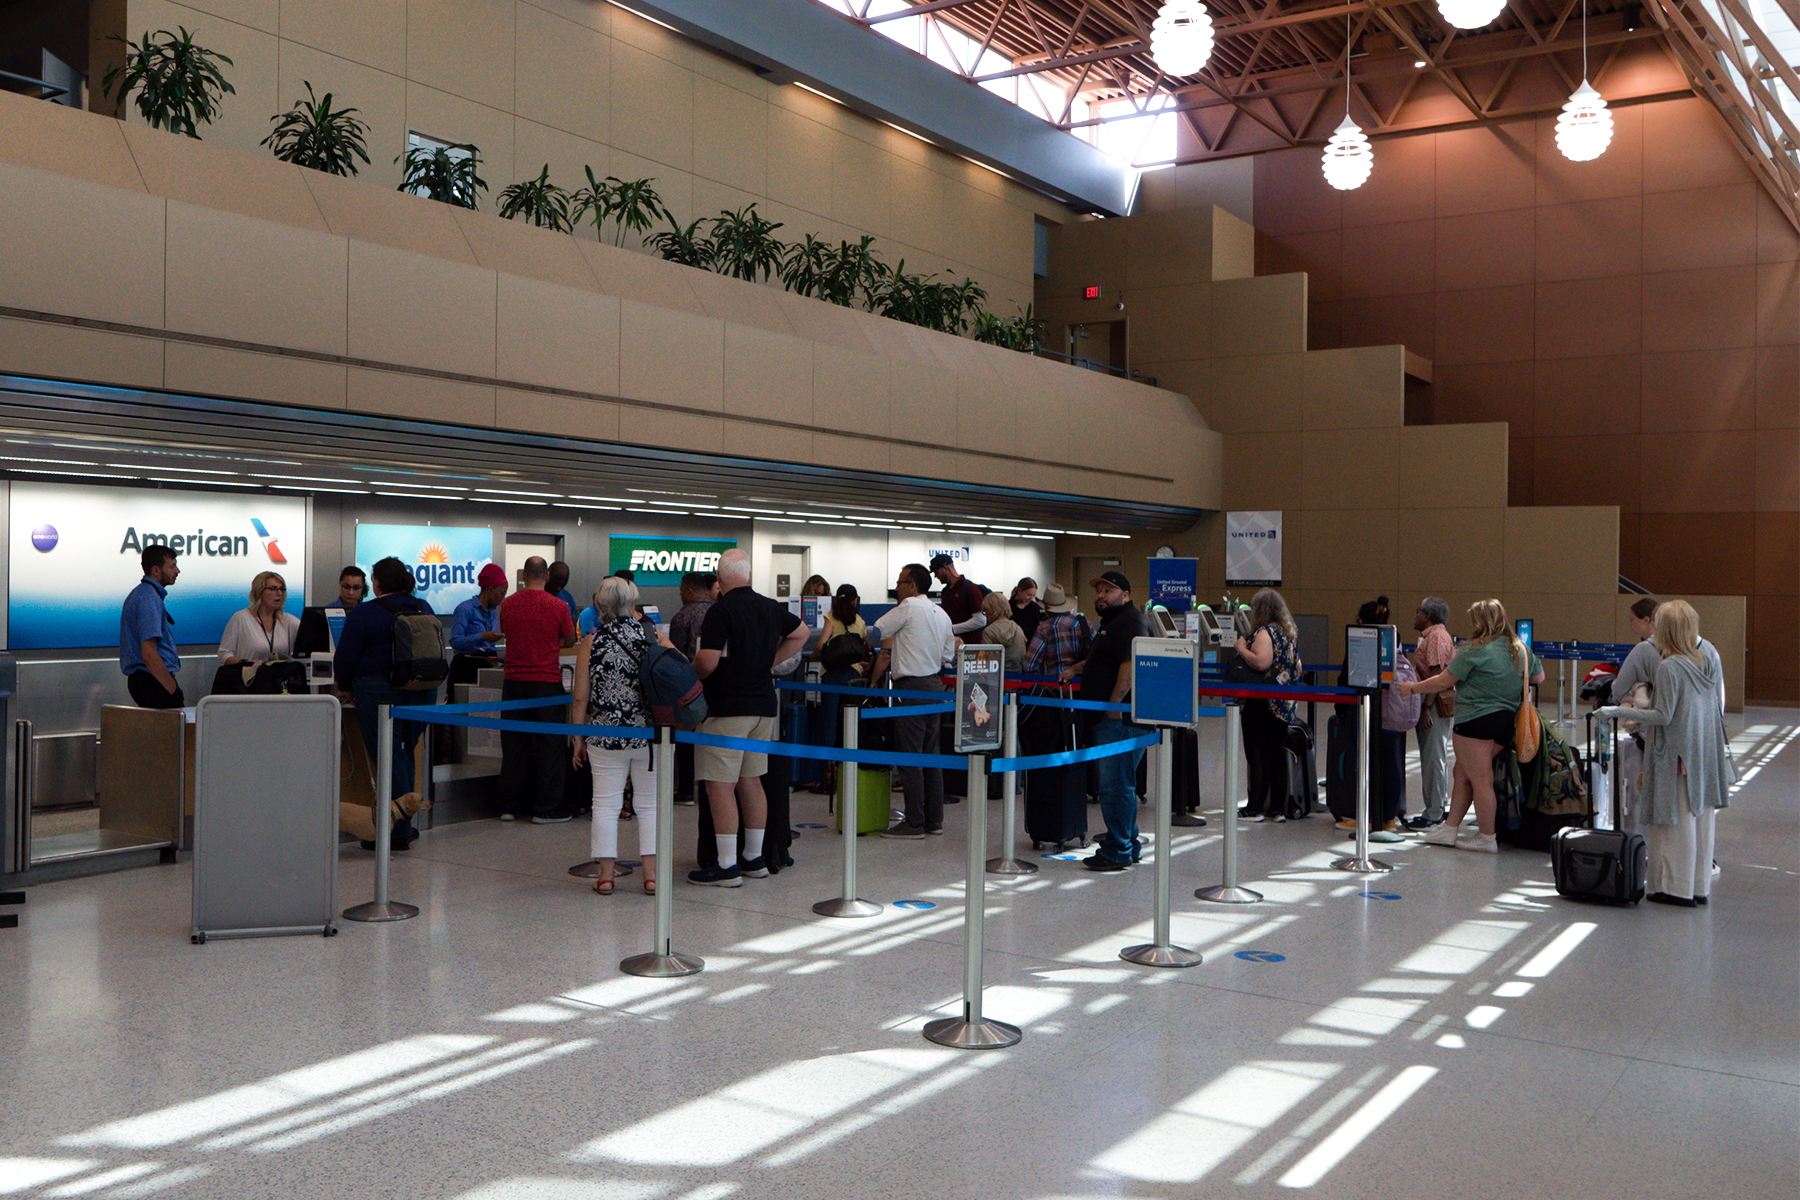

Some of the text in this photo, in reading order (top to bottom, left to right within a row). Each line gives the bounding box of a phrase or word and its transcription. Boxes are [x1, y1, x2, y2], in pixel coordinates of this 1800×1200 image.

[1086, 287, 1098, 298] EXIT
[120, 526, 248, 556] American
[629, 550, 722, 572] FRONTIER
[1162, 584, 1192, 593] Express
[964, 660, 999, 674] REAL ID
[1139, 660, 1159, 668] MAIN
